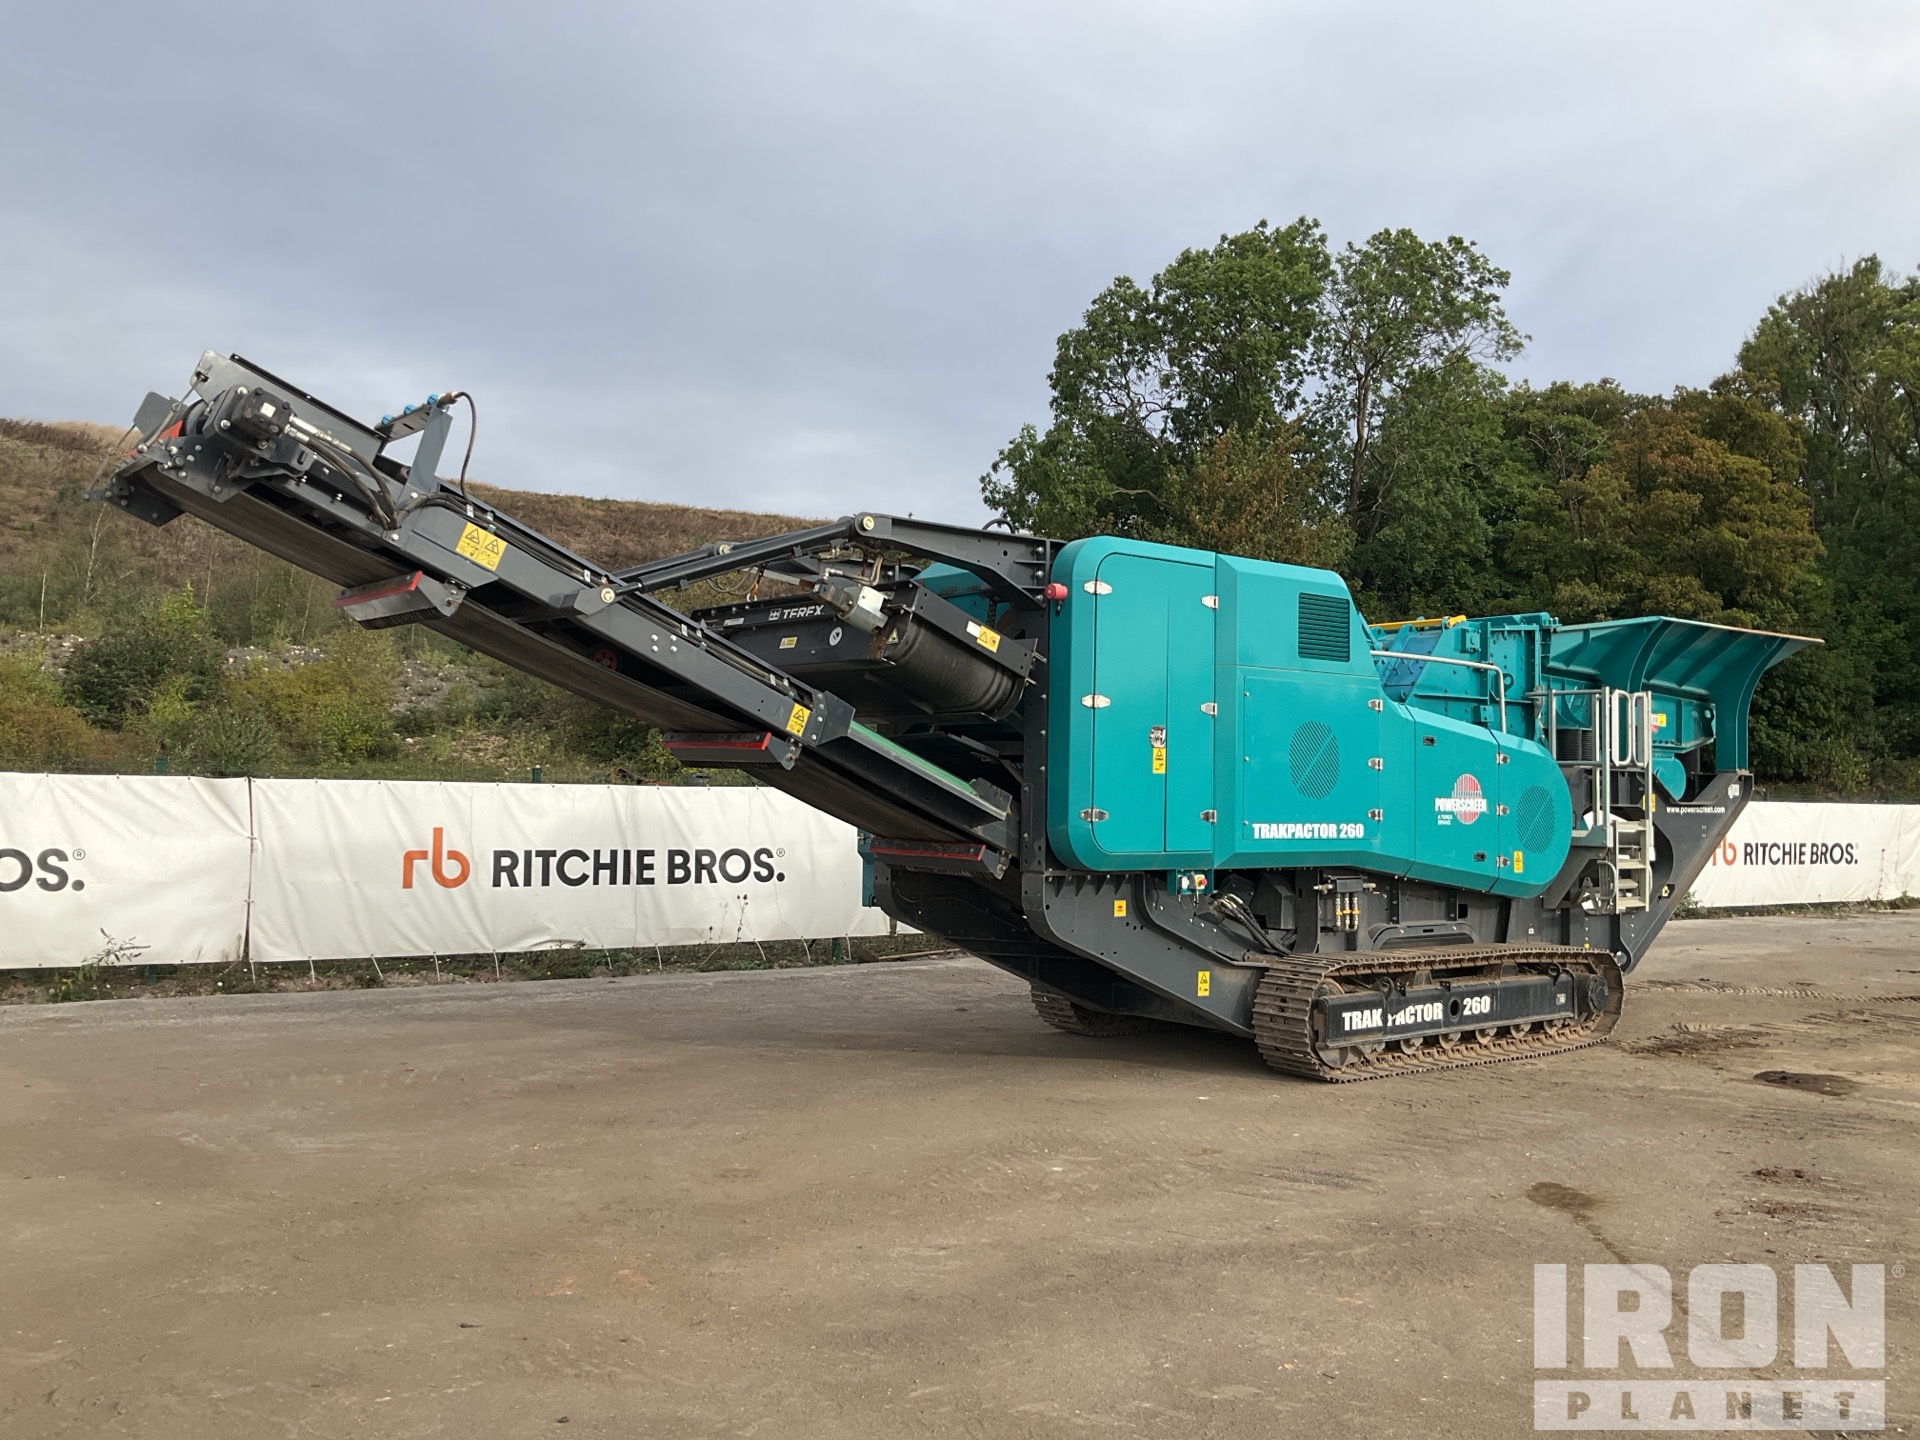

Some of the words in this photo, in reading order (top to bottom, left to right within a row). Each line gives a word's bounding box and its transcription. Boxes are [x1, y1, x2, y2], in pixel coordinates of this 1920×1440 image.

[1435, 797, 1487, 812] POWERSCREEN
[1666, 806, 1726, 815] www.powerscreen.com
[1252, 823, 1337, 839] TRAKPACTOR
[1339, 823, 1364, 838] 260
[402, 827, 471, 889] rb
[1743, 842, 1806, 865] RITCHIE
[492, 849, 656, 888] RITCHIE
[1463, 995, 1491, 1015] 260
